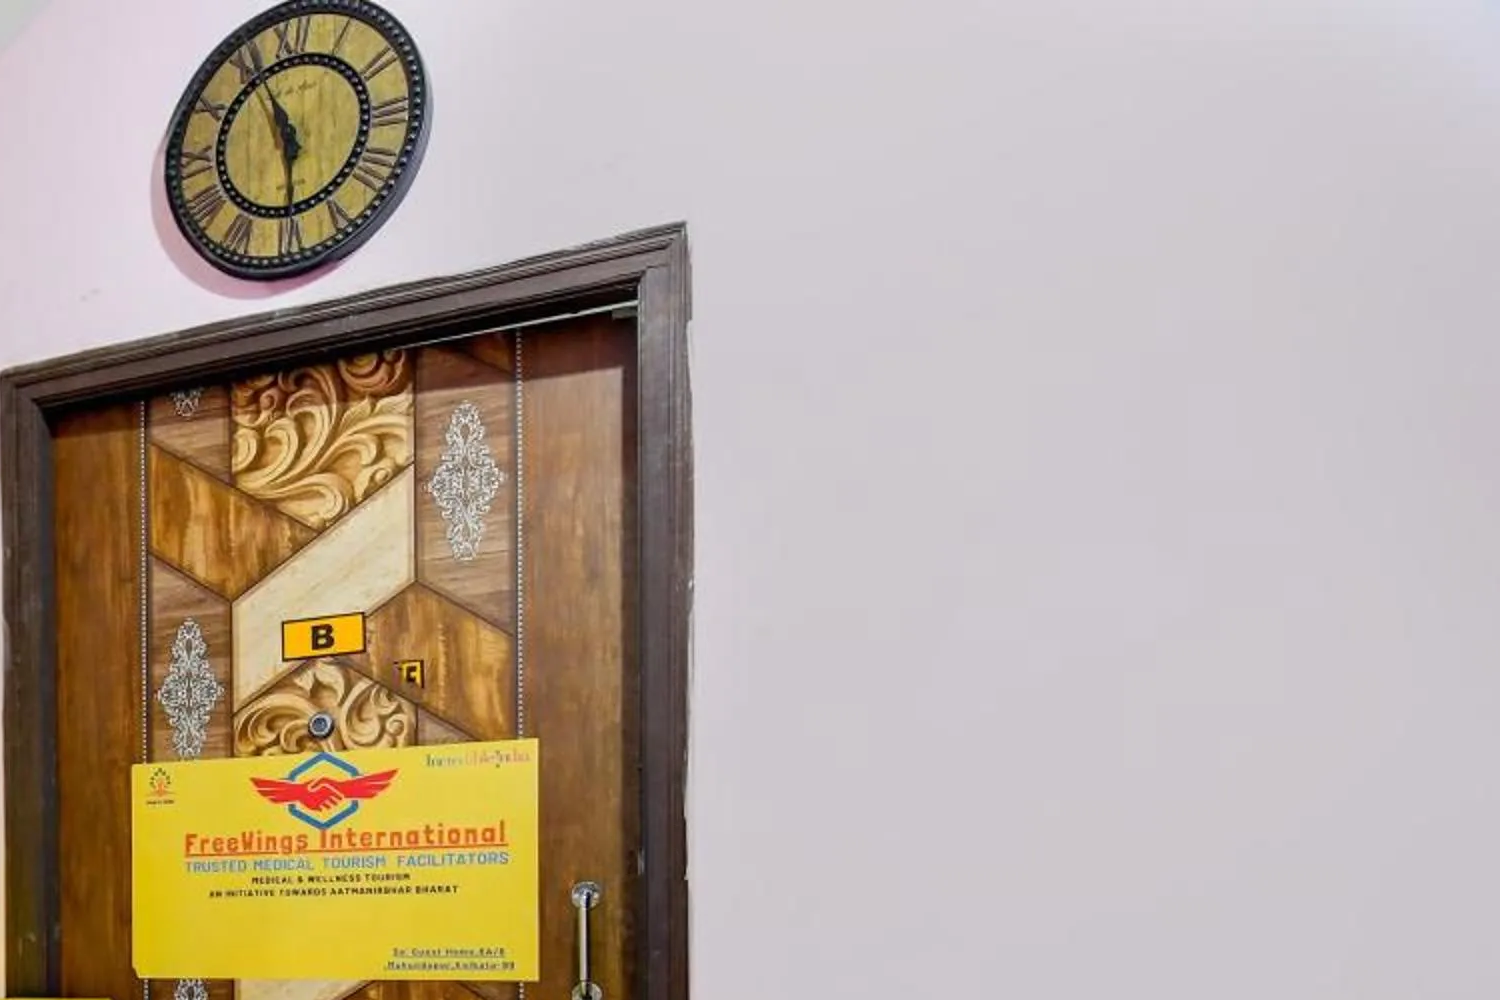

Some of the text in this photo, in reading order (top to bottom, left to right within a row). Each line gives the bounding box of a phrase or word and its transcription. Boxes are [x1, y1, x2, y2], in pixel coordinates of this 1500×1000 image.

[311, 623, 335, 650] B
[184, 819, 506, 855] FreeWings International
[185, 851, 509, 873] TRUSTED MEDICAL TOURISM FACILITATORS
